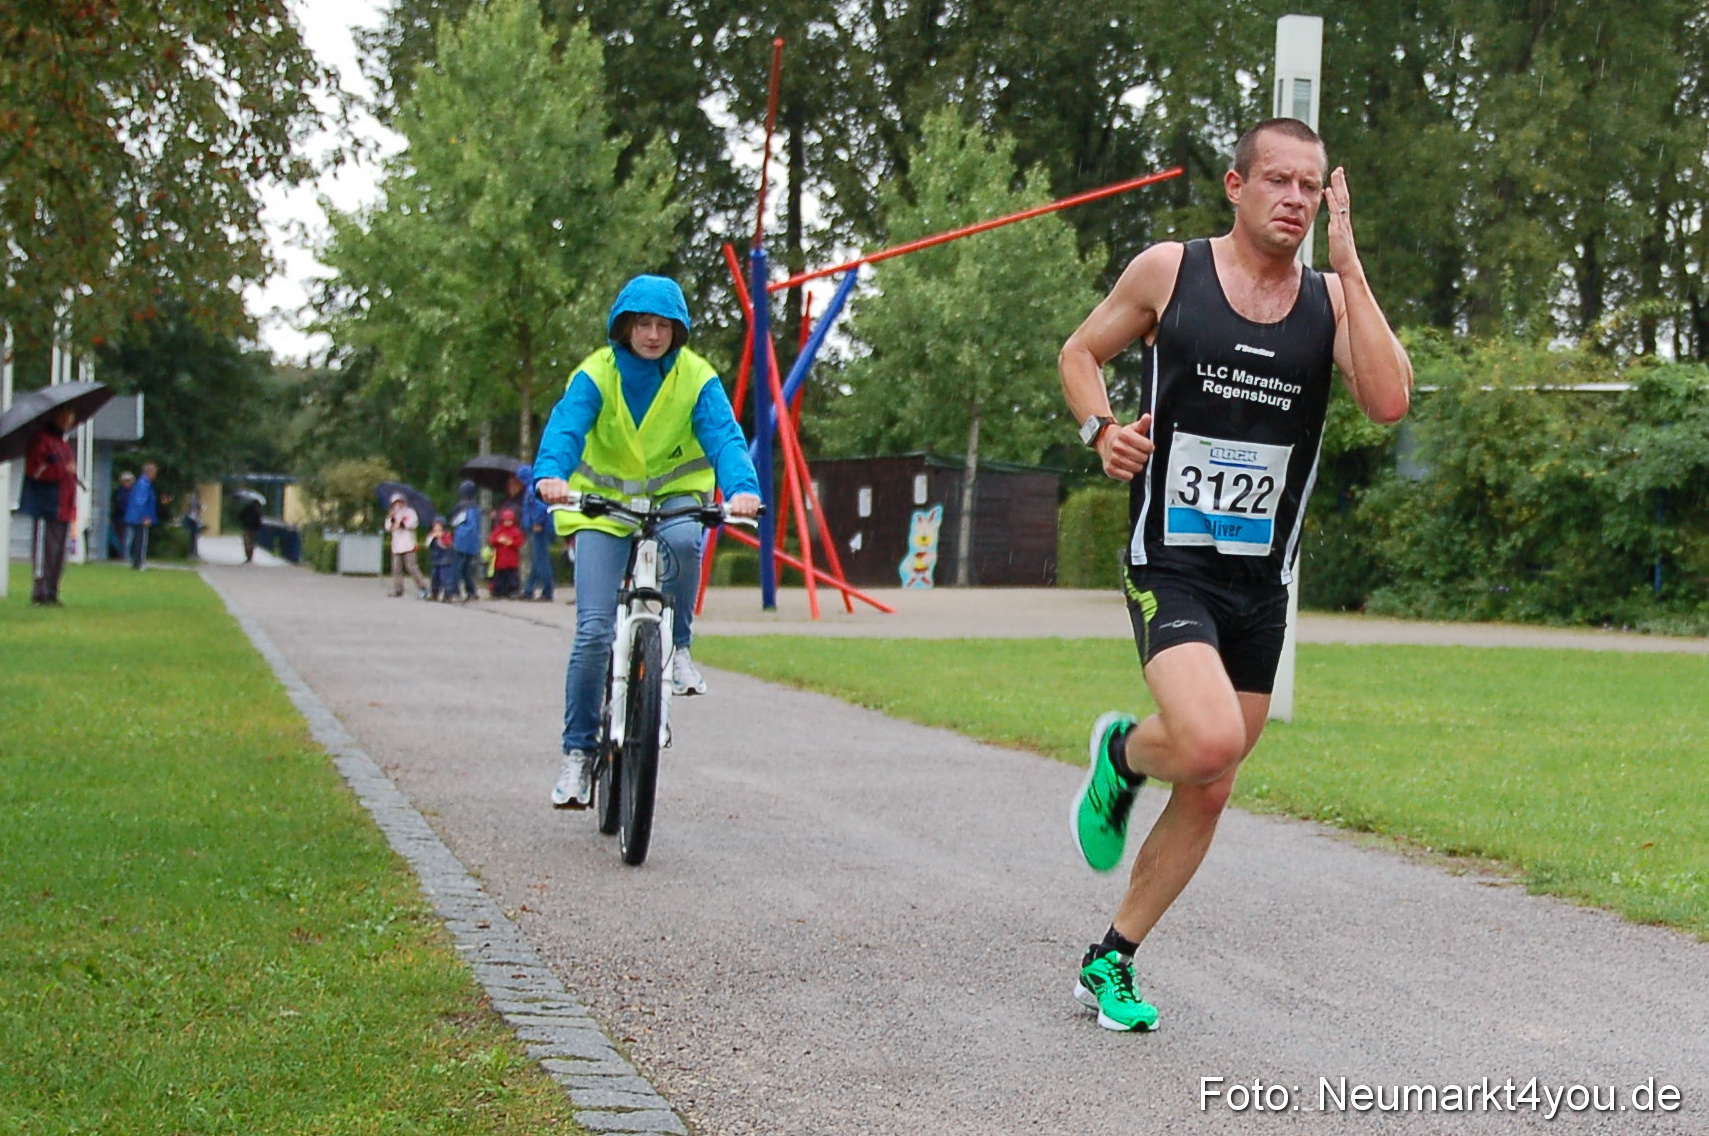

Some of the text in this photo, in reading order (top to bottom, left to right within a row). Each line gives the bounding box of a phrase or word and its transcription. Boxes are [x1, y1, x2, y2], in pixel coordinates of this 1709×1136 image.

[1197, 364, 1302, 395] LLC Marathon
[1203, 381, 1292, 411] Regensburg
[1178, 466, 1274, 514] 3122
